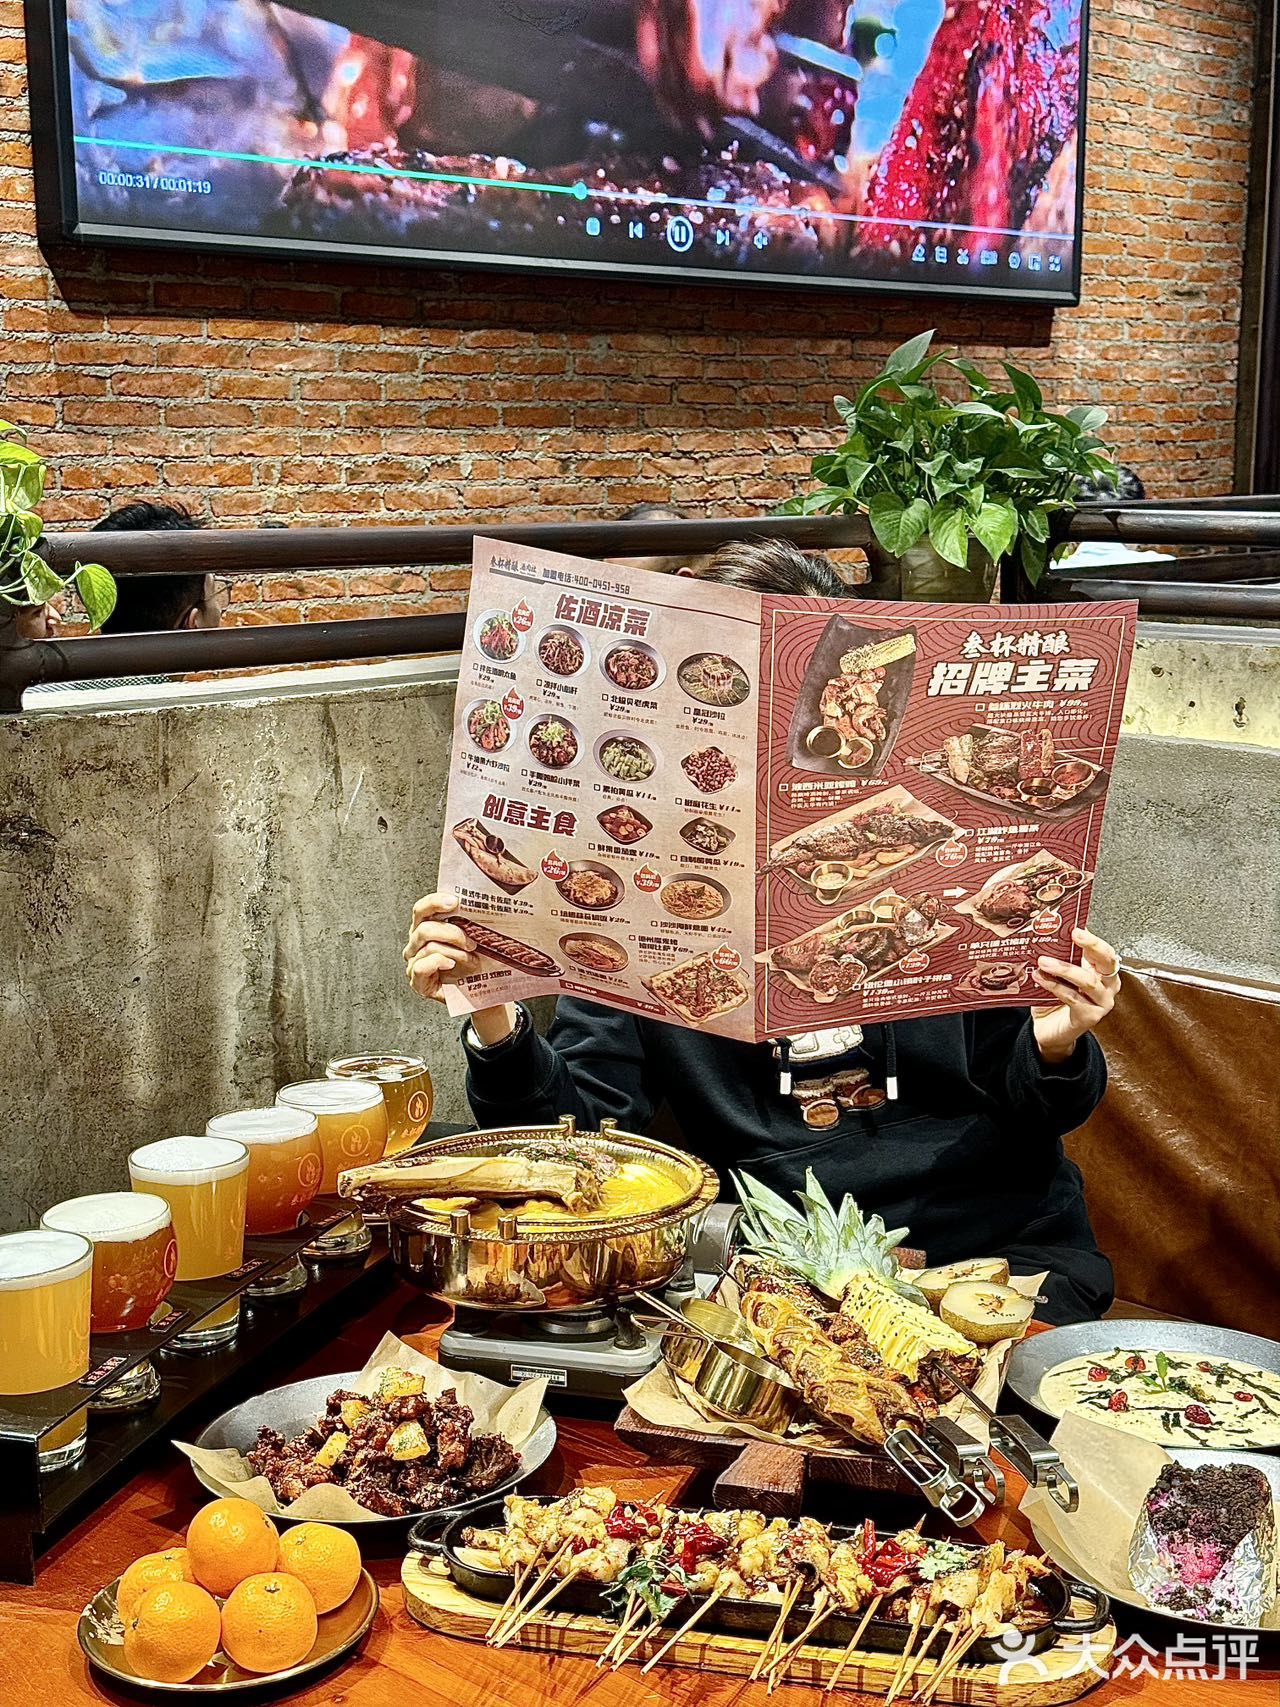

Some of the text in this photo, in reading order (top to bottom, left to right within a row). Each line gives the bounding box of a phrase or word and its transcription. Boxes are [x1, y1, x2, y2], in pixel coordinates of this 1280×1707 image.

[556, 593, 650, 637] 佐酒凉菜
[927, 658, 1100, 697] 招牌主菜
[481, 792, 579, 838] 创意主食
